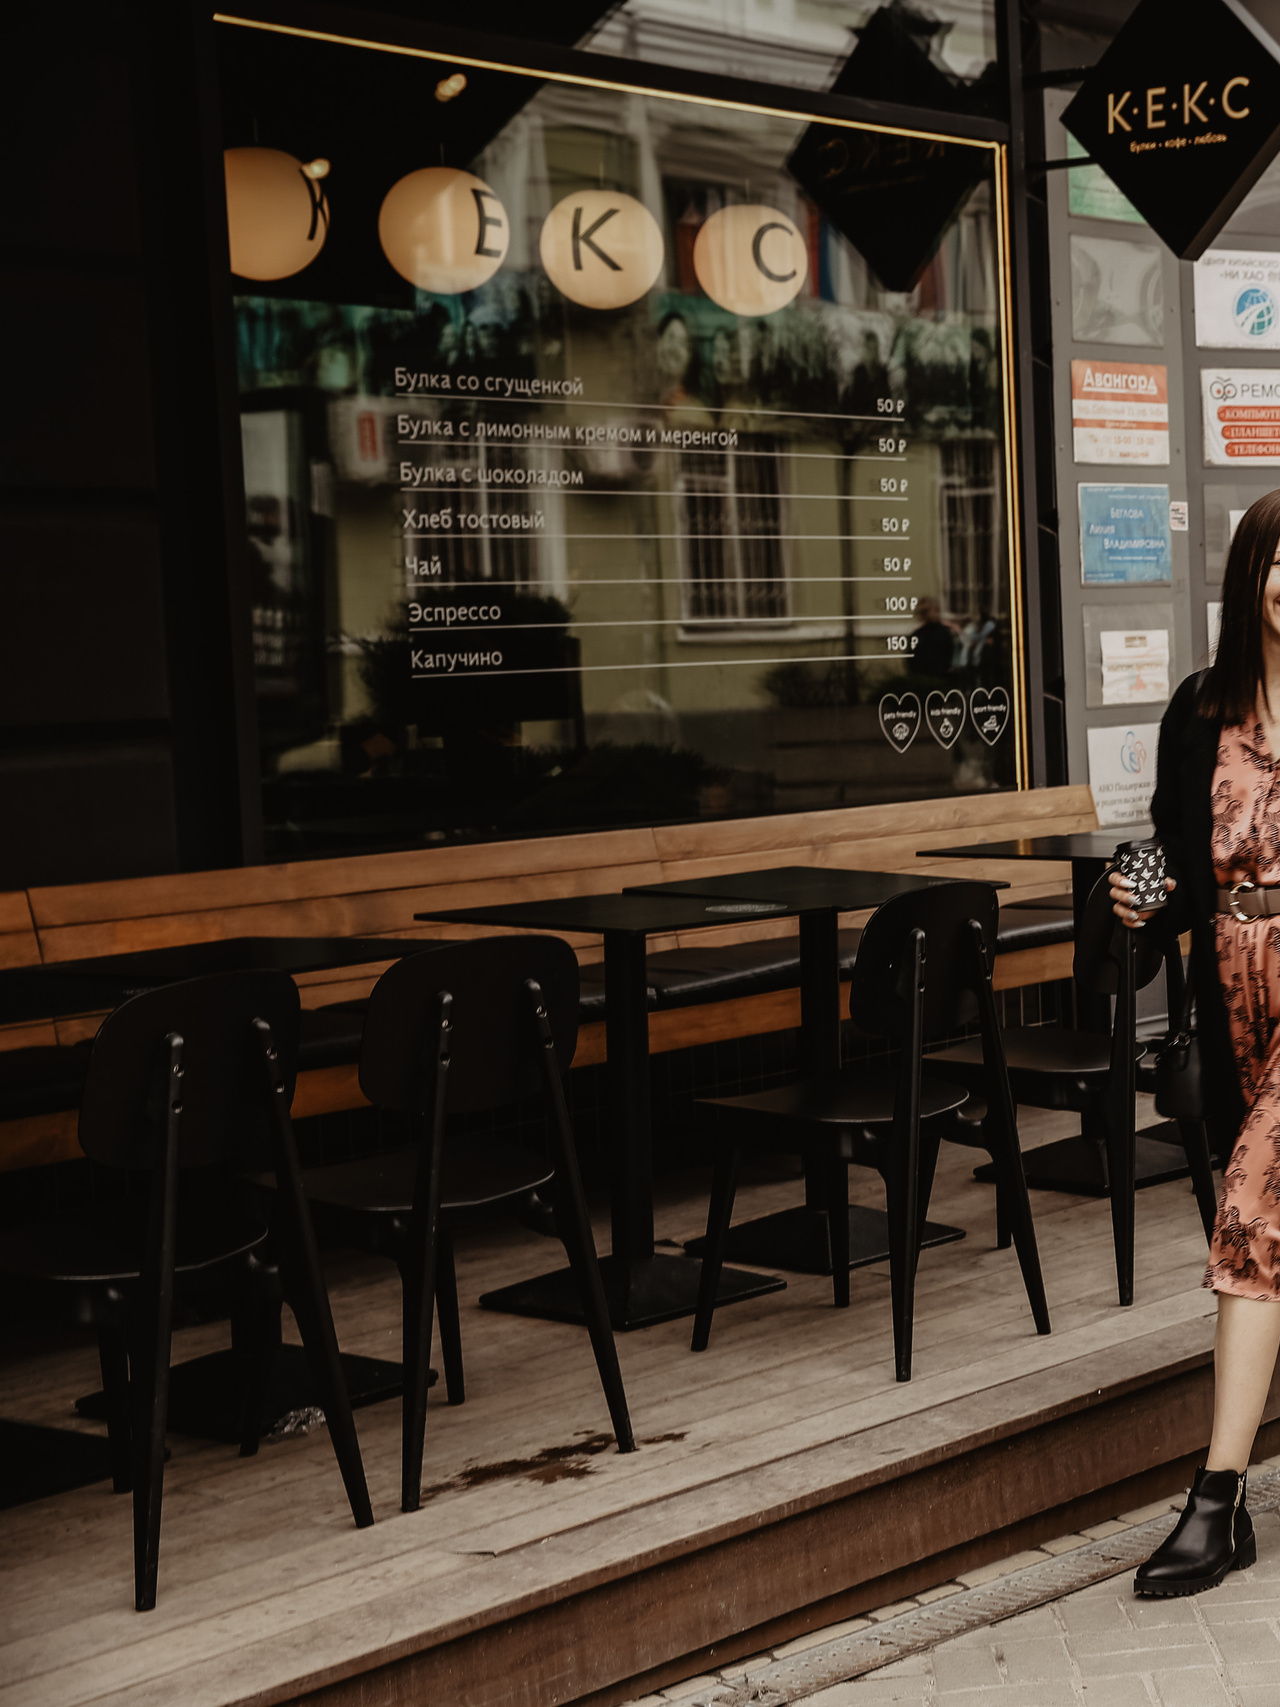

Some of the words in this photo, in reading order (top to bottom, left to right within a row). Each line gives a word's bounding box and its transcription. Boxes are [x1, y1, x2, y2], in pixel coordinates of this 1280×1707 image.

[1165, 136, 1187, 149] кофе
[570, 207, 623, 272] К
[752, 221, 798, 283] С
[394, 367, 451, 392] Булка
[456, 374, 480, 391] со
[484, 376, 584, 396] сгущенкой
[877, 398, 894, 413] 50
[397, 415, 454, 439] Булка
[458, 421, 470, 437] с
[475, 422, 571, 440] лимонным
[574, 426, 642, 447] кремом
[646, 429, 657, 443] и
[660, 429, 739, 449] меренгой
[879, 438, 895, 453] 50
[400, 462, 456, 487] Булка
[461, 467, 472, 483] с
[477, 467, 584, 487] шоколадом
[880, 478, 897, 493] 50
[402, 508, 453, 529] Хлеб
[457, 511, 545, 529] тостовый
[882, 518, 899, 532] 50
[405, 556, 442, 576] Чай
[883, 557, 901, 572] 50
[408, 602, 501, 626] Эспрессо
[885, 597, 907, 611] 100
[411, 649, 503, 672] Капучино
[886, 636, 908, 651] 150
[883, 712, 896, 721] pets
[896, 710, 917, 719] friendly
[941, 707, 962, 716] friendly
[987, 704, 1007, 712] friendly
